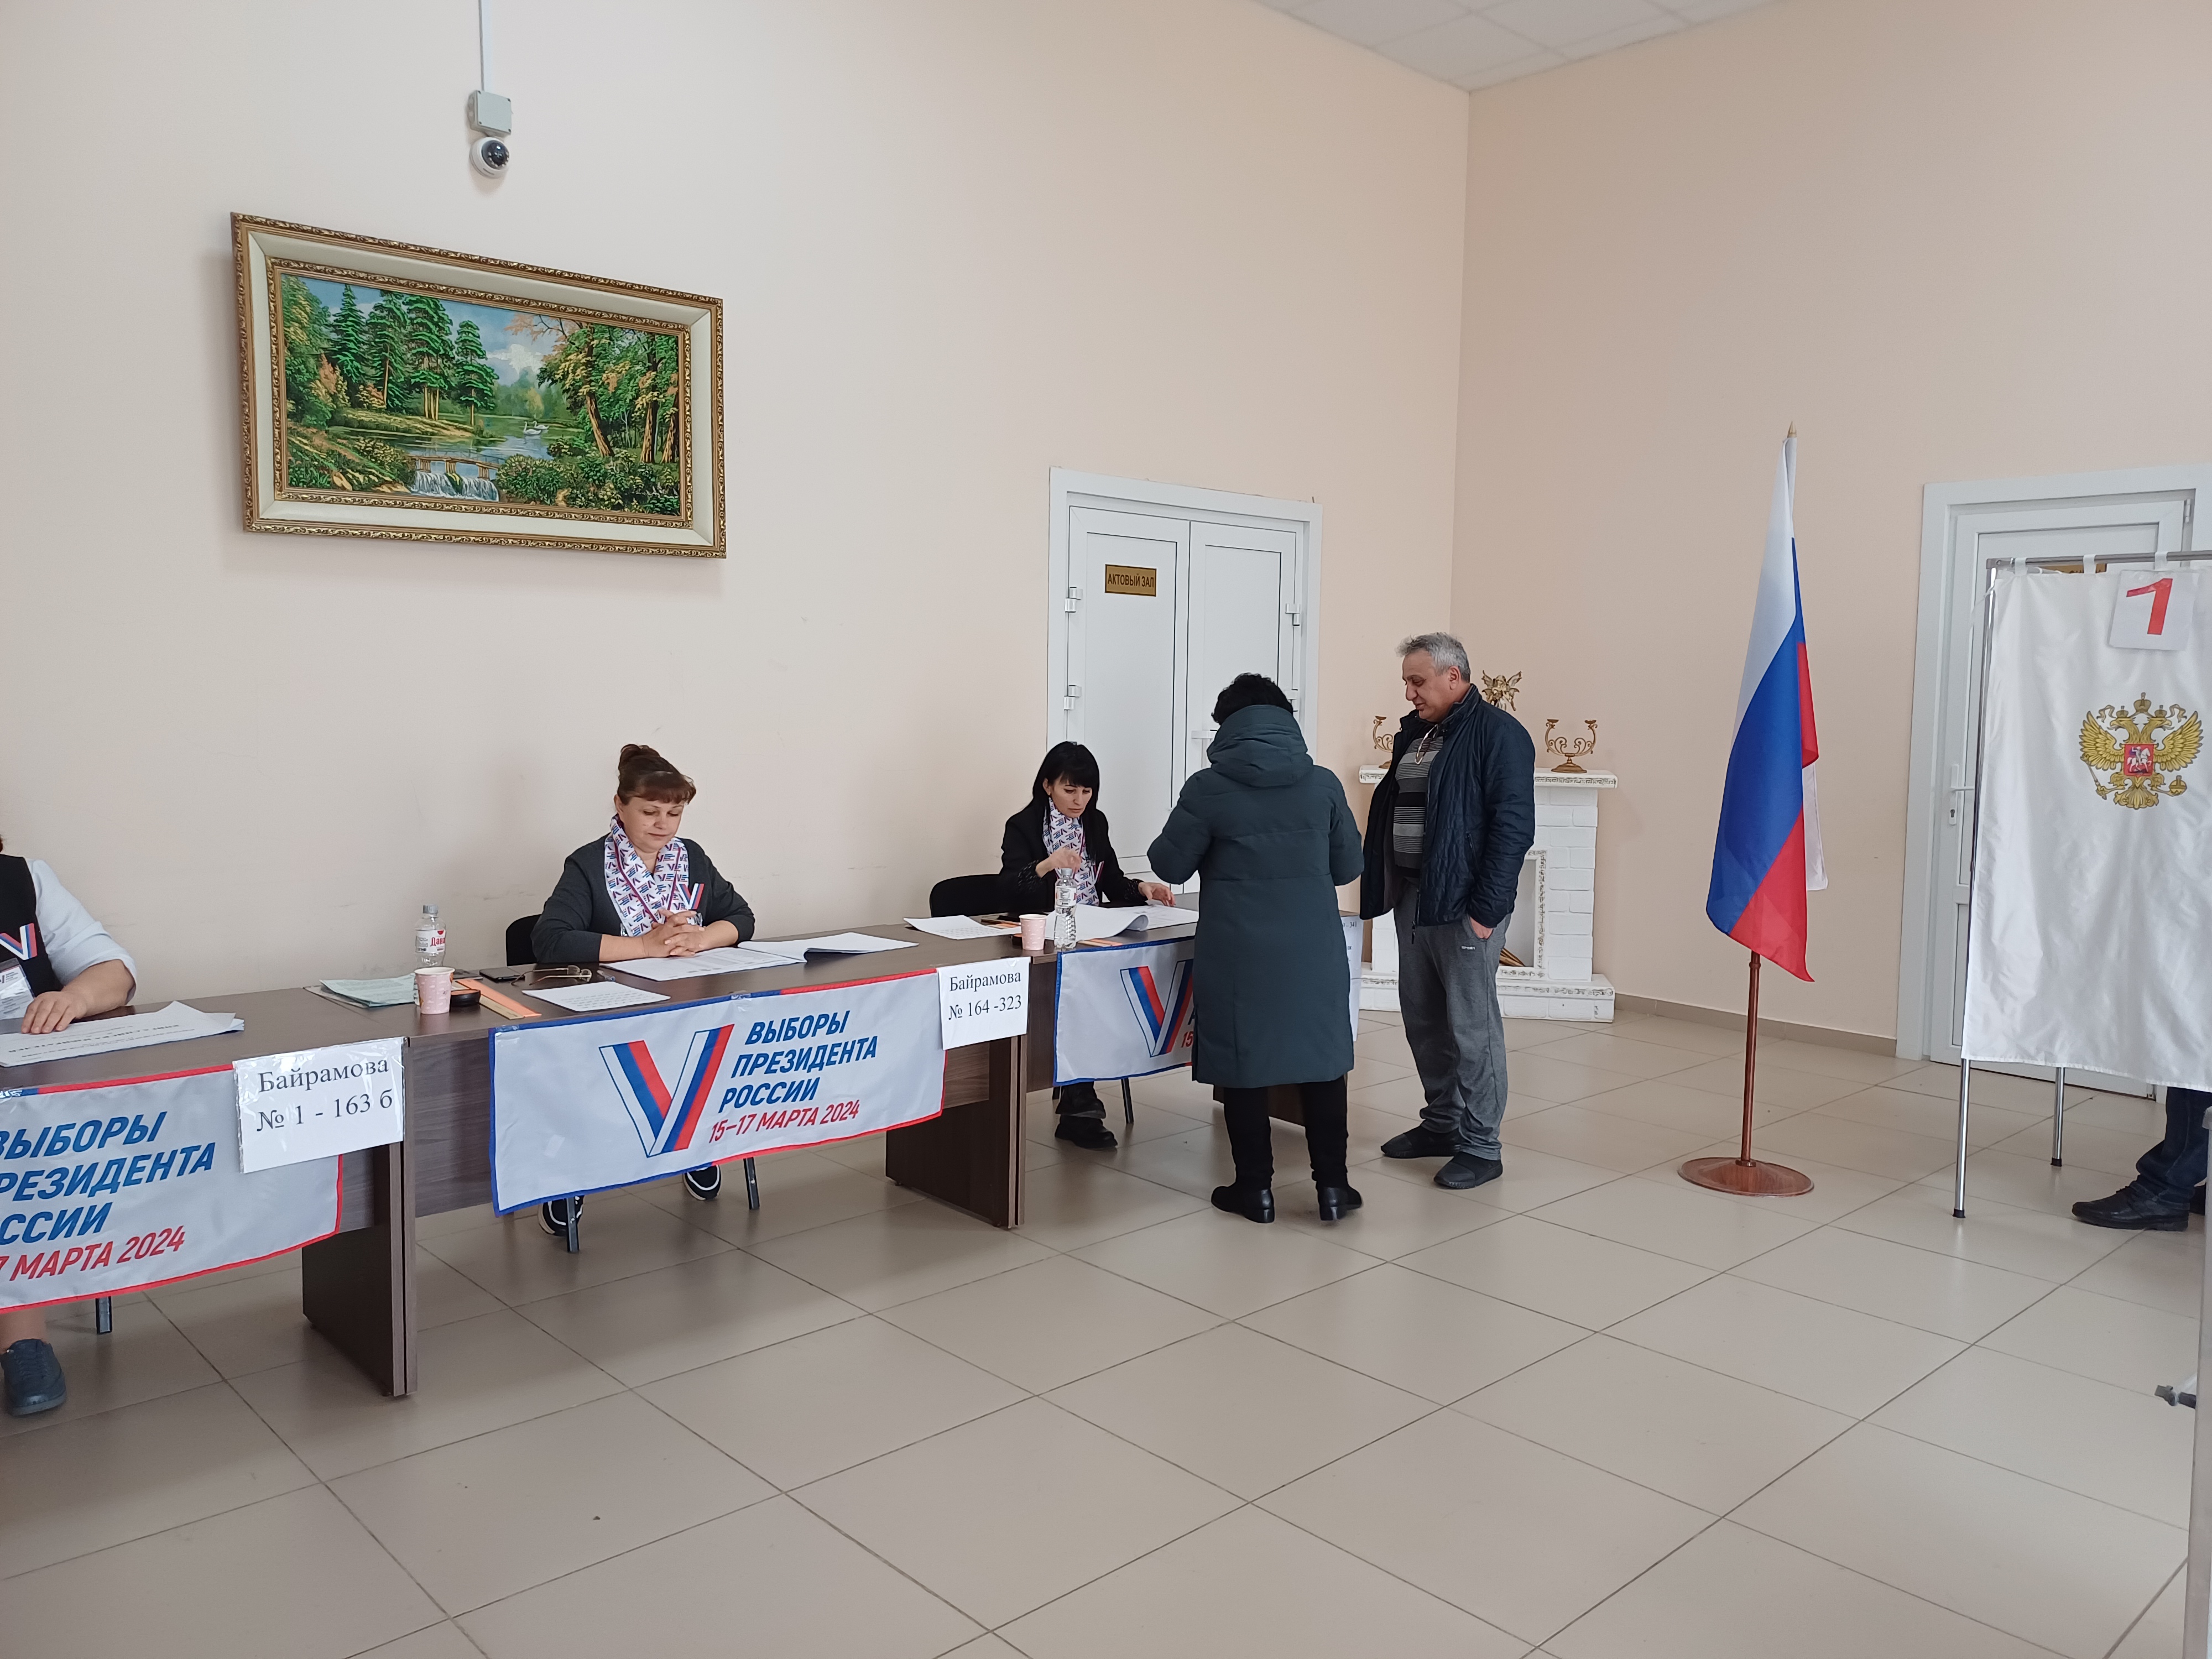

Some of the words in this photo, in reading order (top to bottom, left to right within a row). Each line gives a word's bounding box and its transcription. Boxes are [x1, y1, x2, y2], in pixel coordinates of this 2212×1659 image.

[1108, 573, 1140, 586] АКТОВЫЙ
[1141, 576, 1154, 587] ЗАЛ
[2126, 578, 2173, 635] 1
[950, 972, 1021, 992] Байрамова
[745, 1010, 850, 1045] ВЫБОРЫ
[948, 1004, 963, 1020] №
[968, 999, 990, 1016] 164
[731, 1036, 878, 1078] ПРЕЗИДЕНТА
[258, 1060, 389, 1093] Байрамова
[718, 1077, 820, 1113] РОССИИ
[257, 1109, 284, 1131] №
[295, 1105, 304, 1125] 1
[334, 1093, 371, 1118] 163
[755, 1107, 819, 1131] МАРТА
[819, 1099, 860, 1125] 2024
[0, 1112, 167, 1160] ЫБОРЫ
[0, 1142, 215, 1201] РЕЗИДЕНТА
[0, 1202, 113, 1245] ССИИ
[9, 1241, 113, 1281] МАРТА
[117, 1225, 185, 1264] 2024
